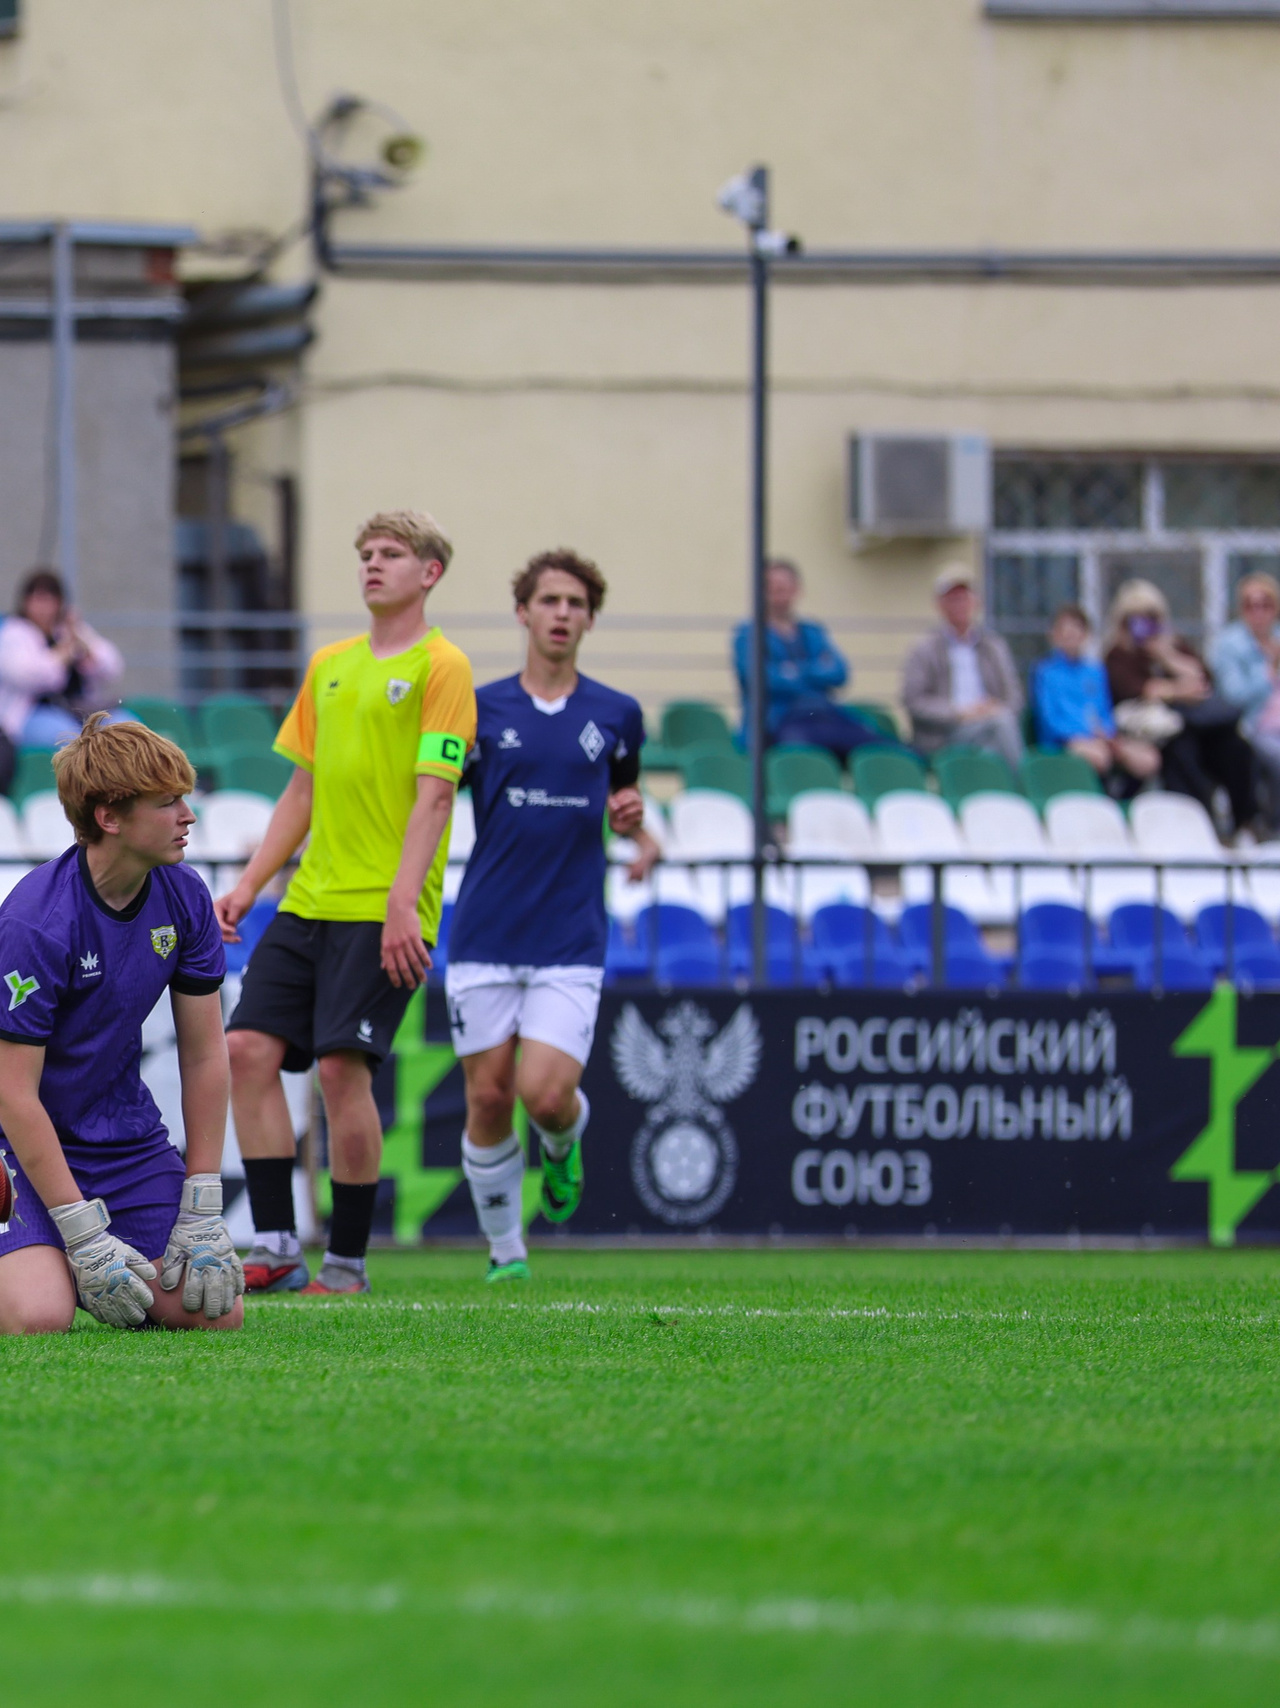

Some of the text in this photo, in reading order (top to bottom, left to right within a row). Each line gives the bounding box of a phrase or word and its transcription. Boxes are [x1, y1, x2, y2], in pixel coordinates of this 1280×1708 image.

[794, 1006, 1117, 1075] РОССИЙСКИЙ
[791, 1073, 1133, 1141] ФУТБОЛЬНЫЙ
[791, 1149, 932, 1206] СОЮЗ
